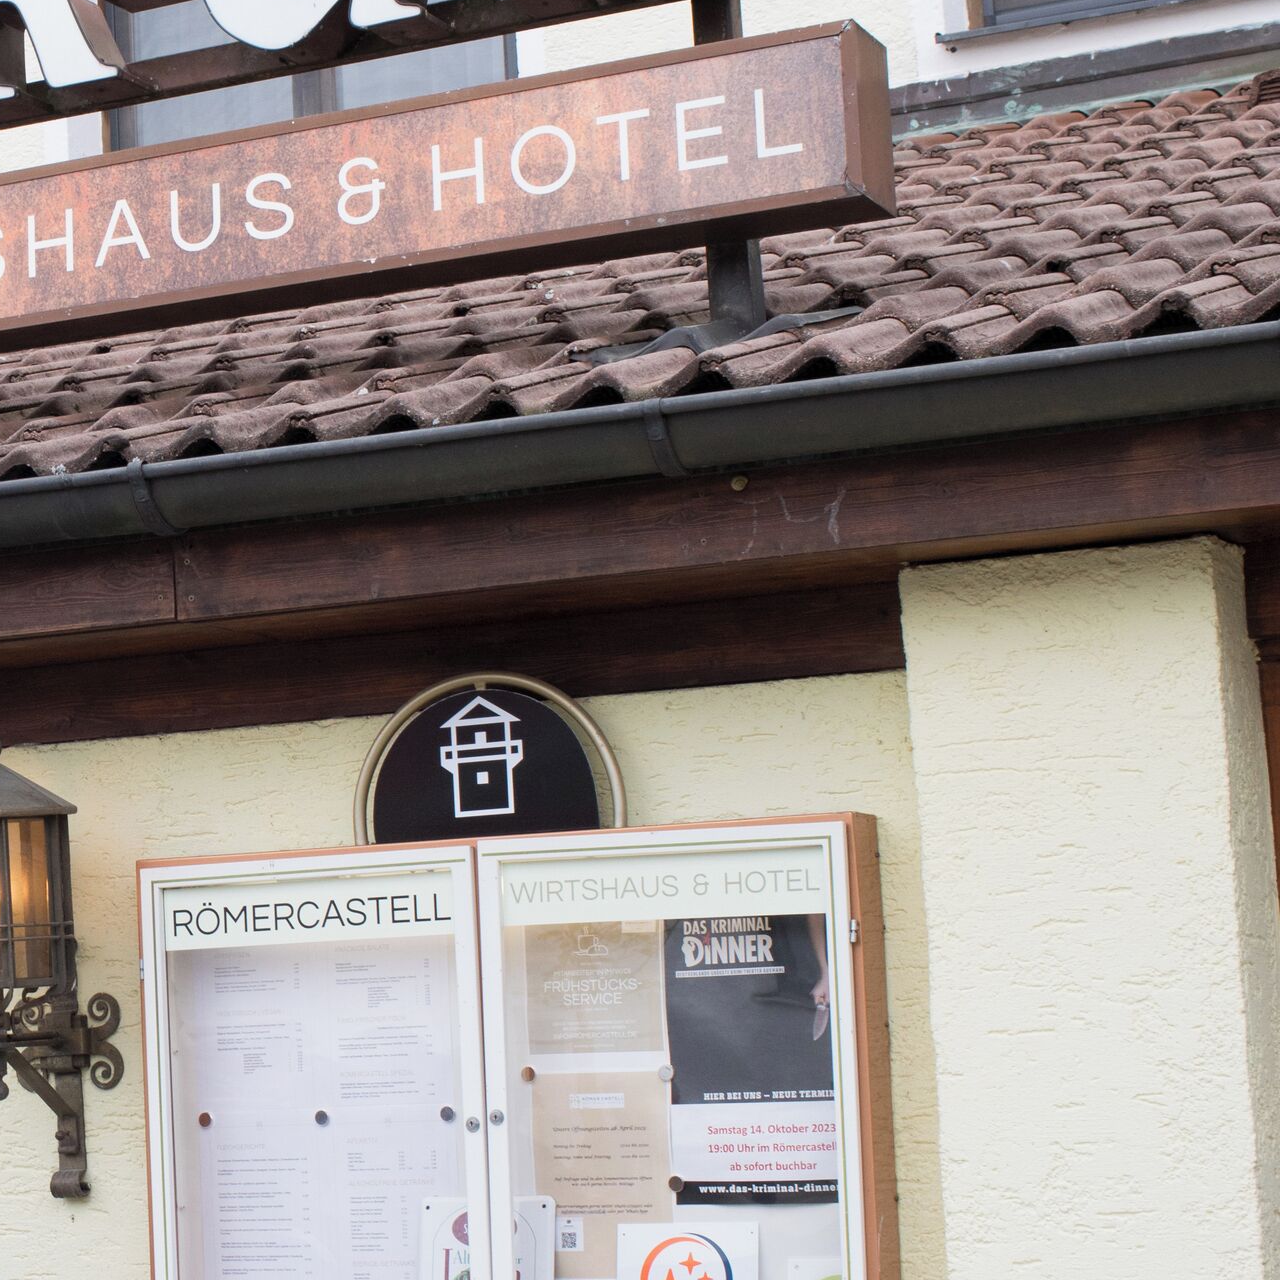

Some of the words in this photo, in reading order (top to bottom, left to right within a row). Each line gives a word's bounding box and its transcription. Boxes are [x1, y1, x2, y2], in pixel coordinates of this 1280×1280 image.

[337, 157, 385, 225] &
[431, 89, 803, 211] HOTEL
[510, 874, 680, 904] WIRTSHAUS
[693, 873, 710, 896] &
[725, 868, 821, 895] HOTEL
[173, 893, 452, 937] RÖMERCASTELL
[683, 919, 708, 935] DAS
[711, 916, 772, 934] KRIMINAL
[544, 976, 642, 993] FRÜHSTÜCKS-
[563, 992, 624, 1006] SERVICE
[703, 1092, 725, 1101] HIER
[727, 1092, 742, 1100] BEI
[743, 1091, 761, 1100] UNS
[772, 1090, 797, 1099] NEUE
[708, 1125, 748, 1136] Samstag
[750, 1125, 765, 1135] 14.
[768, 1124, 808, 1135] Oktober
[811, 1123, 836, 1133] 2023
[708, 1143, 734, 1153] 19:00
[737, 1142, 755, 1153] Uhr
[757, 1142, 770, 1152] im
[730, 1162, 742, 1171] ab
[744, 1161, 773, 1171] sofort
[775, 1160, 817, 1171] buchbar
